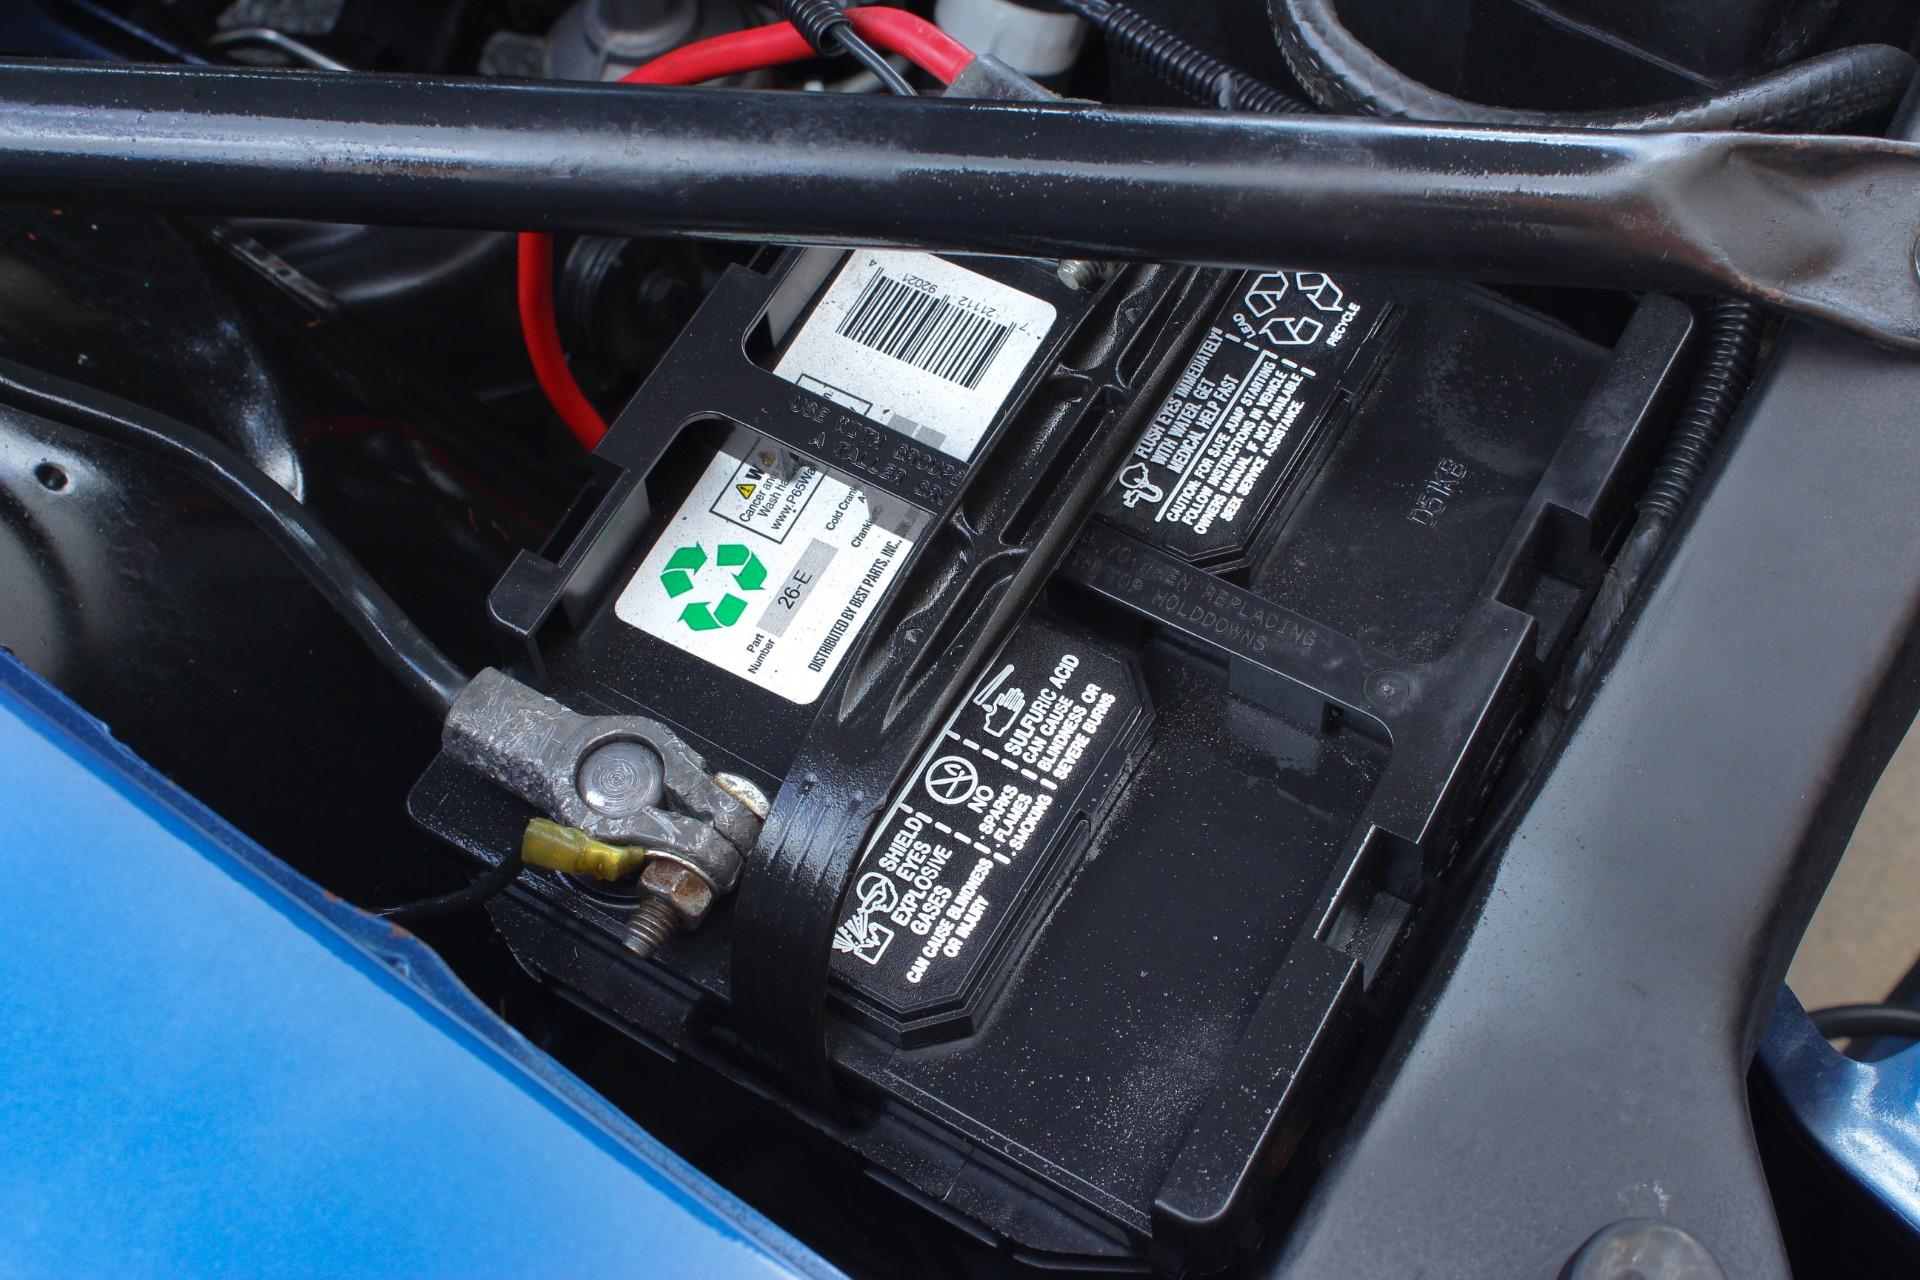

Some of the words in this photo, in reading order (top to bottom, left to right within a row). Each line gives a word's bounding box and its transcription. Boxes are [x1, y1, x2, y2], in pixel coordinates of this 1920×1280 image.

[868, 258, 877, 268] 4
[902, 272, 939, 294] 92021
[958, 296, 997, 318] 21112
[1018, 322, 1029, 332] 7
[1233, 313, 1257, 339] LEAD
[1326, 302, 1361, 347] RECYCLE
[1249, 407, 1264, 420] IN
[1256, 370, 1288, 407] VEHICLE
[1135, 423, 1166, 459] FLUSH
[1157, 398, 1183, 426] EYES
[1149, 437, 1178, 465] WITH
[1193, 377, 1216, 400] GET
[1166, 480, 1202, 522] CAUTION:
[1193, 457, 1215, 479] FOR
[1207, 432, 1231, 458] SAFE
[1224, 406, 1246, 433] JUMP
[1240, 361, 1276, 407] STARTING
[1167, 430, 1206, 474] MEDICAL
[1195, 401, 1221, 430] HELP
[1213, 373, 1239, 402] FAST
[1193, 494, 1227, 534] OWNERS
[1245, 440, 1259, 453] IF
[1253, 420, 1273, 441] NOT
[1267, 373, 1304, 420] AVAILABLE
[1206, 420, 1256, 487] INSTRUCTIONS
[1219, 495, 1244, 521] SEEK
[1236, 455, 1268, 496] SERVICE
[1261, 400, 1305, 457] ASSISTANCE.
[739, 490, 766, 522] Cancer
[757, 491, 782, 517] Wash
[770, 467, 817, 530] www.P65Wa
[825, 509, 844, 531] Cold
[1181, 485, 1214, 525] FOLLOW
[777, 569, 813, 610] 26-E
[848, 584, 871, 609] BEST
[862, 558, 890, 588] PARTS,
[840, 605, 857, 622] BY
[1150, 590, 1269, 653] HOLDDOWNS
[1201, 584, 1317, 649] REPLACING
[746, 633, 765, 653] Part
[747, 638, 775, 674] Number
[807, 618, 850, 673] DISTRIBUTED
[1003, 688, 1057, 756] SULFURIC
[1049, 654, 1080, 689] ACID
[1022, 736, 1047, 764] CAN
[1040, 695, 1074, 736] CAUSE
[1036, 704, 1088, 772] BLINDNESS
[1081, 683, 1102, 703] OR
[1052, 732, 1091, 780] SEVERE
[1081, 692, 1116, 734] BURNS
[967, 785, 995, 814] NO
[978, 784, 1019, 835] SPARKS
[993, 793, 1033, 844] FLAMES
[1008, 793, 1053, 852] SMOKING
[878, 816, 923, 872] SHIELD
[896, 840, 932, 882] EYES
[890, 844, 953, 927] EXPLOSIVE
[909, 884, 953, 936] GASES
[905, 956, 931, 984] CAN
[922, 918, 955, 958] CAUSE
[945, 857, 994, 921] BLINDNESS
[943, 937, 964, 958] OR
[954, 894, 989, 939] INJURY
